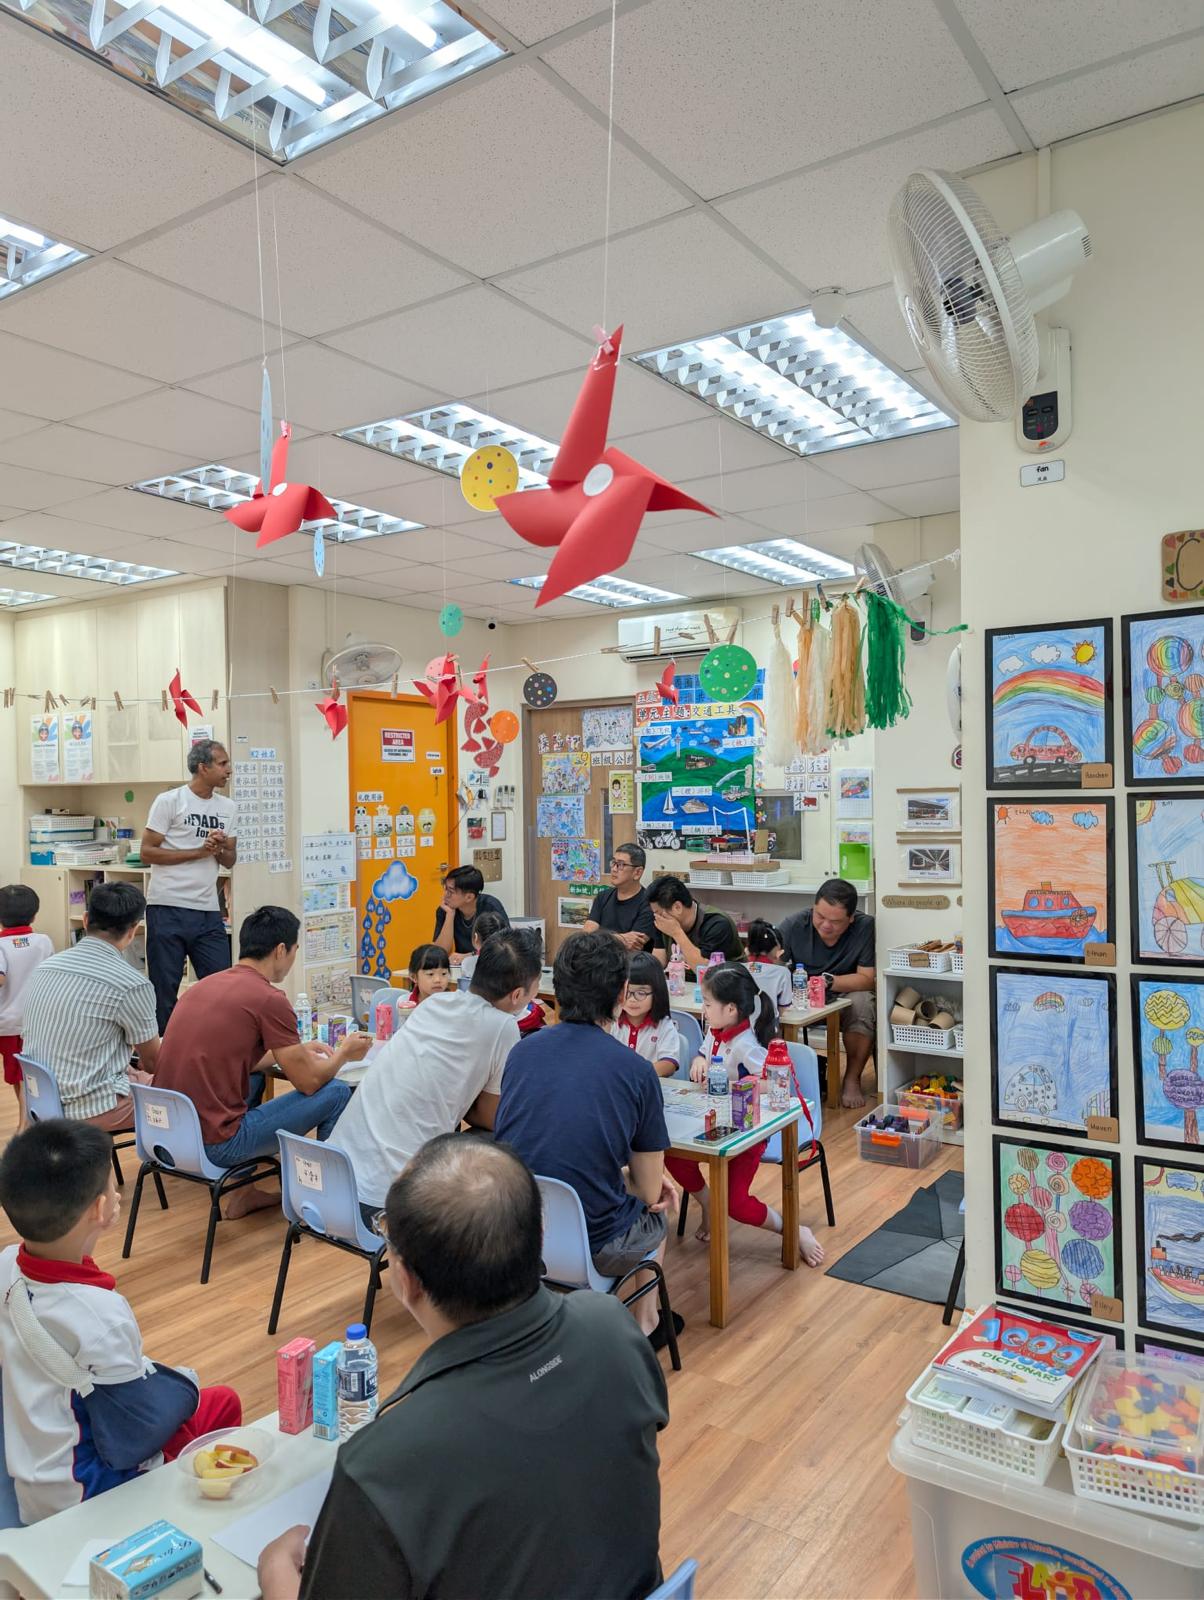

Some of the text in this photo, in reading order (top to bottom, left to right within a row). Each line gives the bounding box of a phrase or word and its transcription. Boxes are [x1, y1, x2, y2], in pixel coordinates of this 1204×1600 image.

[1036, 465, 1049, 473] fan
[384, 731, 411, 739] RESTRICTED
[195, 827, 209, 838] for
[1090, 1122, 1112, 1132] Maven
[1094, 1299, 1114, 1313] Riley
[981, 1350, 1063, 1382] DICTIONARY
